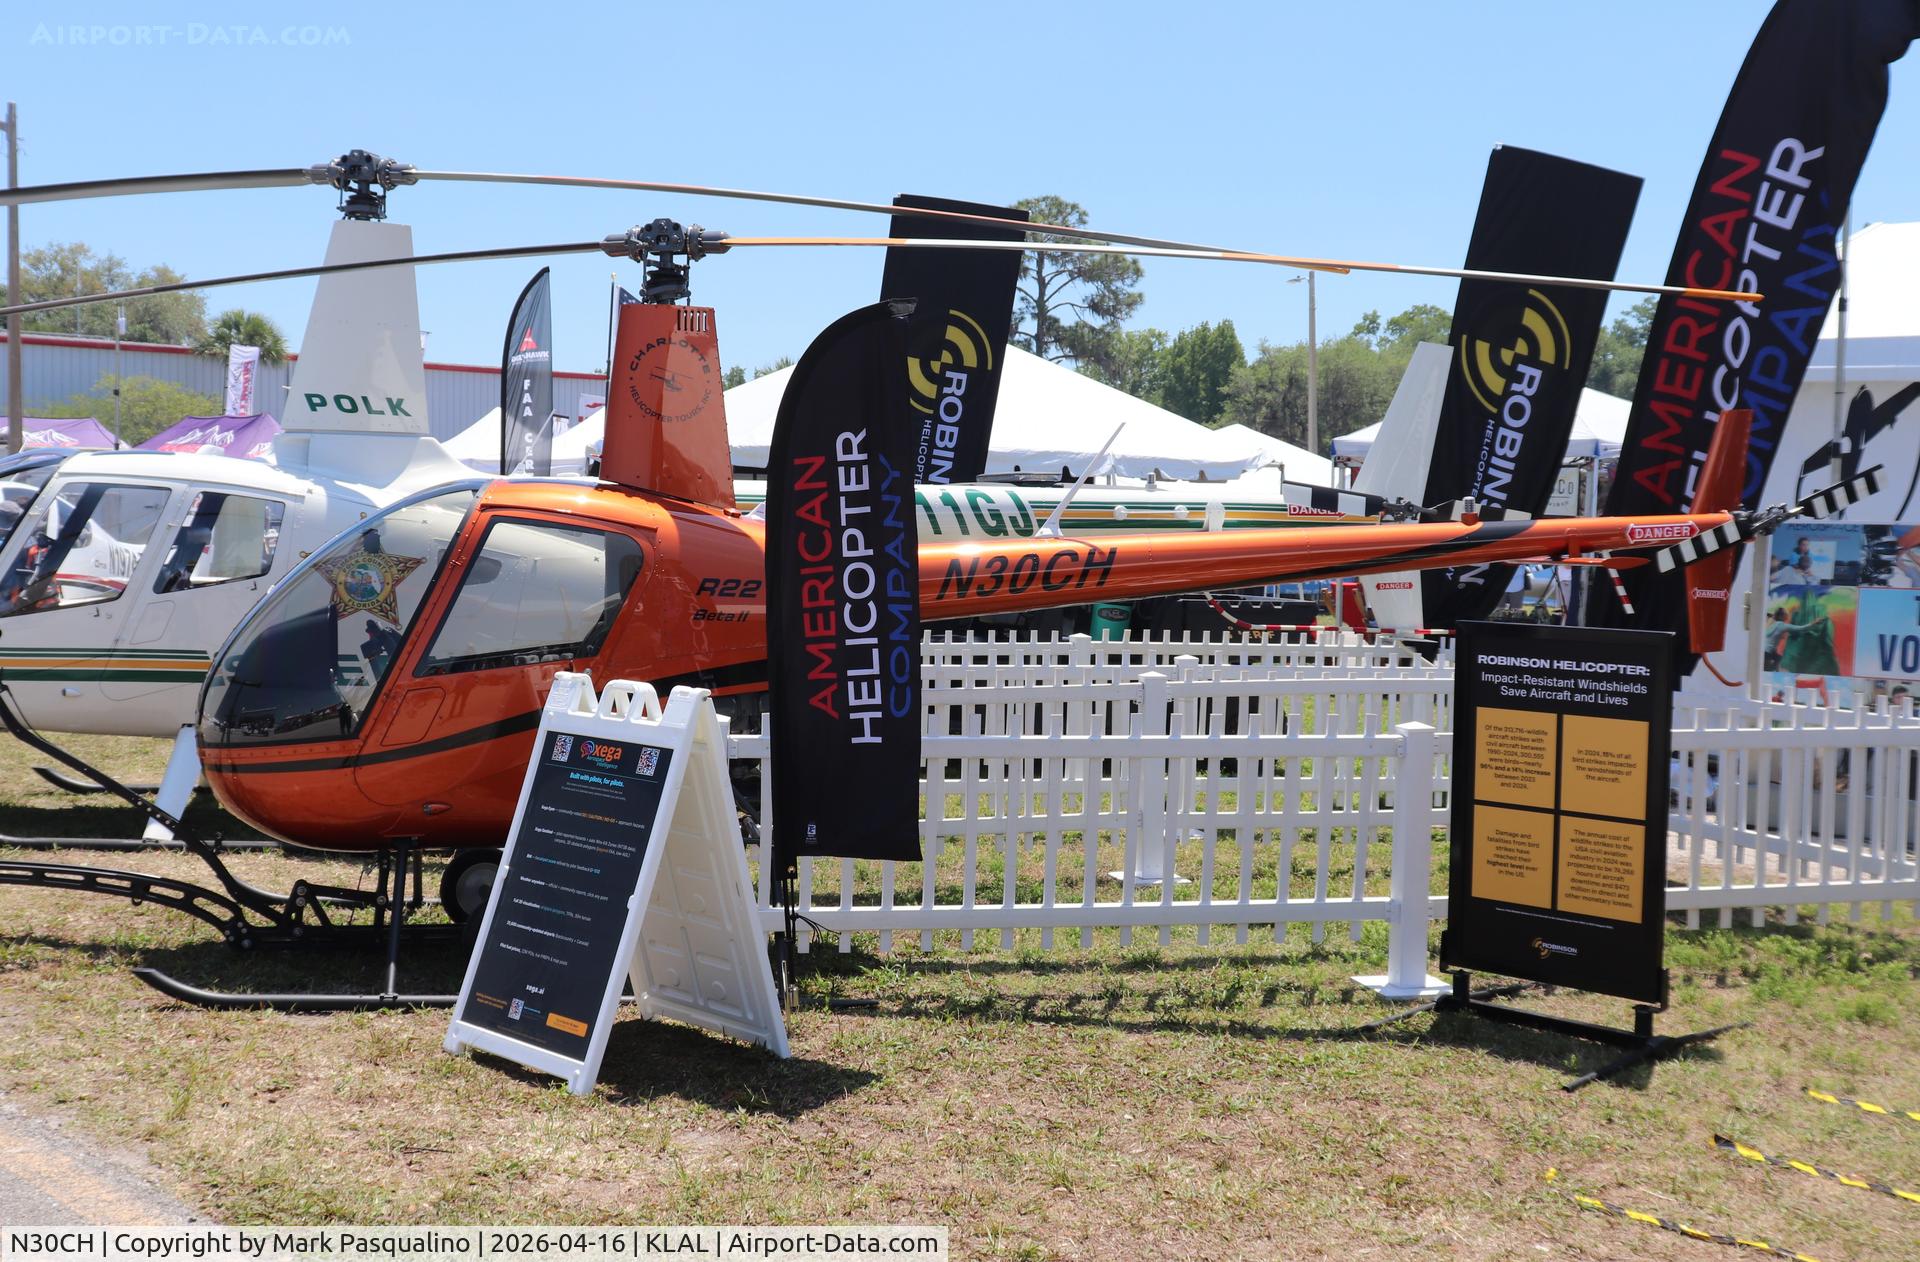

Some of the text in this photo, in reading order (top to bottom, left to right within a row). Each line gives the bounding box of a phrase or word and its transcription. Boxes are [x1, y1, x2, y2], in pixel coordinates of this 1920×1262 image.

[1634, 149, 1761, 504] AMERICAN
[1742, 189, 1838, 499] OMPAN
[630, 337, 710, 374] CHARLOTTE
[304, 393, 412, 416] POLK
[630, 385, 672, 423] HELICOPTER
[928, 370, 968, 484] ROBIN
[524, 432, 535, 476] CER
[914, 420, 932, 484] HELICOPTE
[1472, 418, 1495, 498] HELICOPTE
[1634, 526, 1690, 539] DANGER
[696, 578, 762, 598] R22
[793, 456, 840, 720] AMERICAN
[836, 428, 882, 744] HELICOPTER
[878, 453, 913, 718] COMPANY
[936, 547, 1118, 600] N30CH
[1696, 590, 1725, 598] DANGER
[694, 608, 735, 622] Beta
[1478, 654, 1651, 676] ROBINSON HELICOPTER:
[1481, 672, 1648, 694] Impact-Resistant Windshields
[1501, 686, 1628, 706] Save Aircraft and Lives
[592, 745, 622, 762] xega
[1542, 942, 1578, 953] ROBINSON
